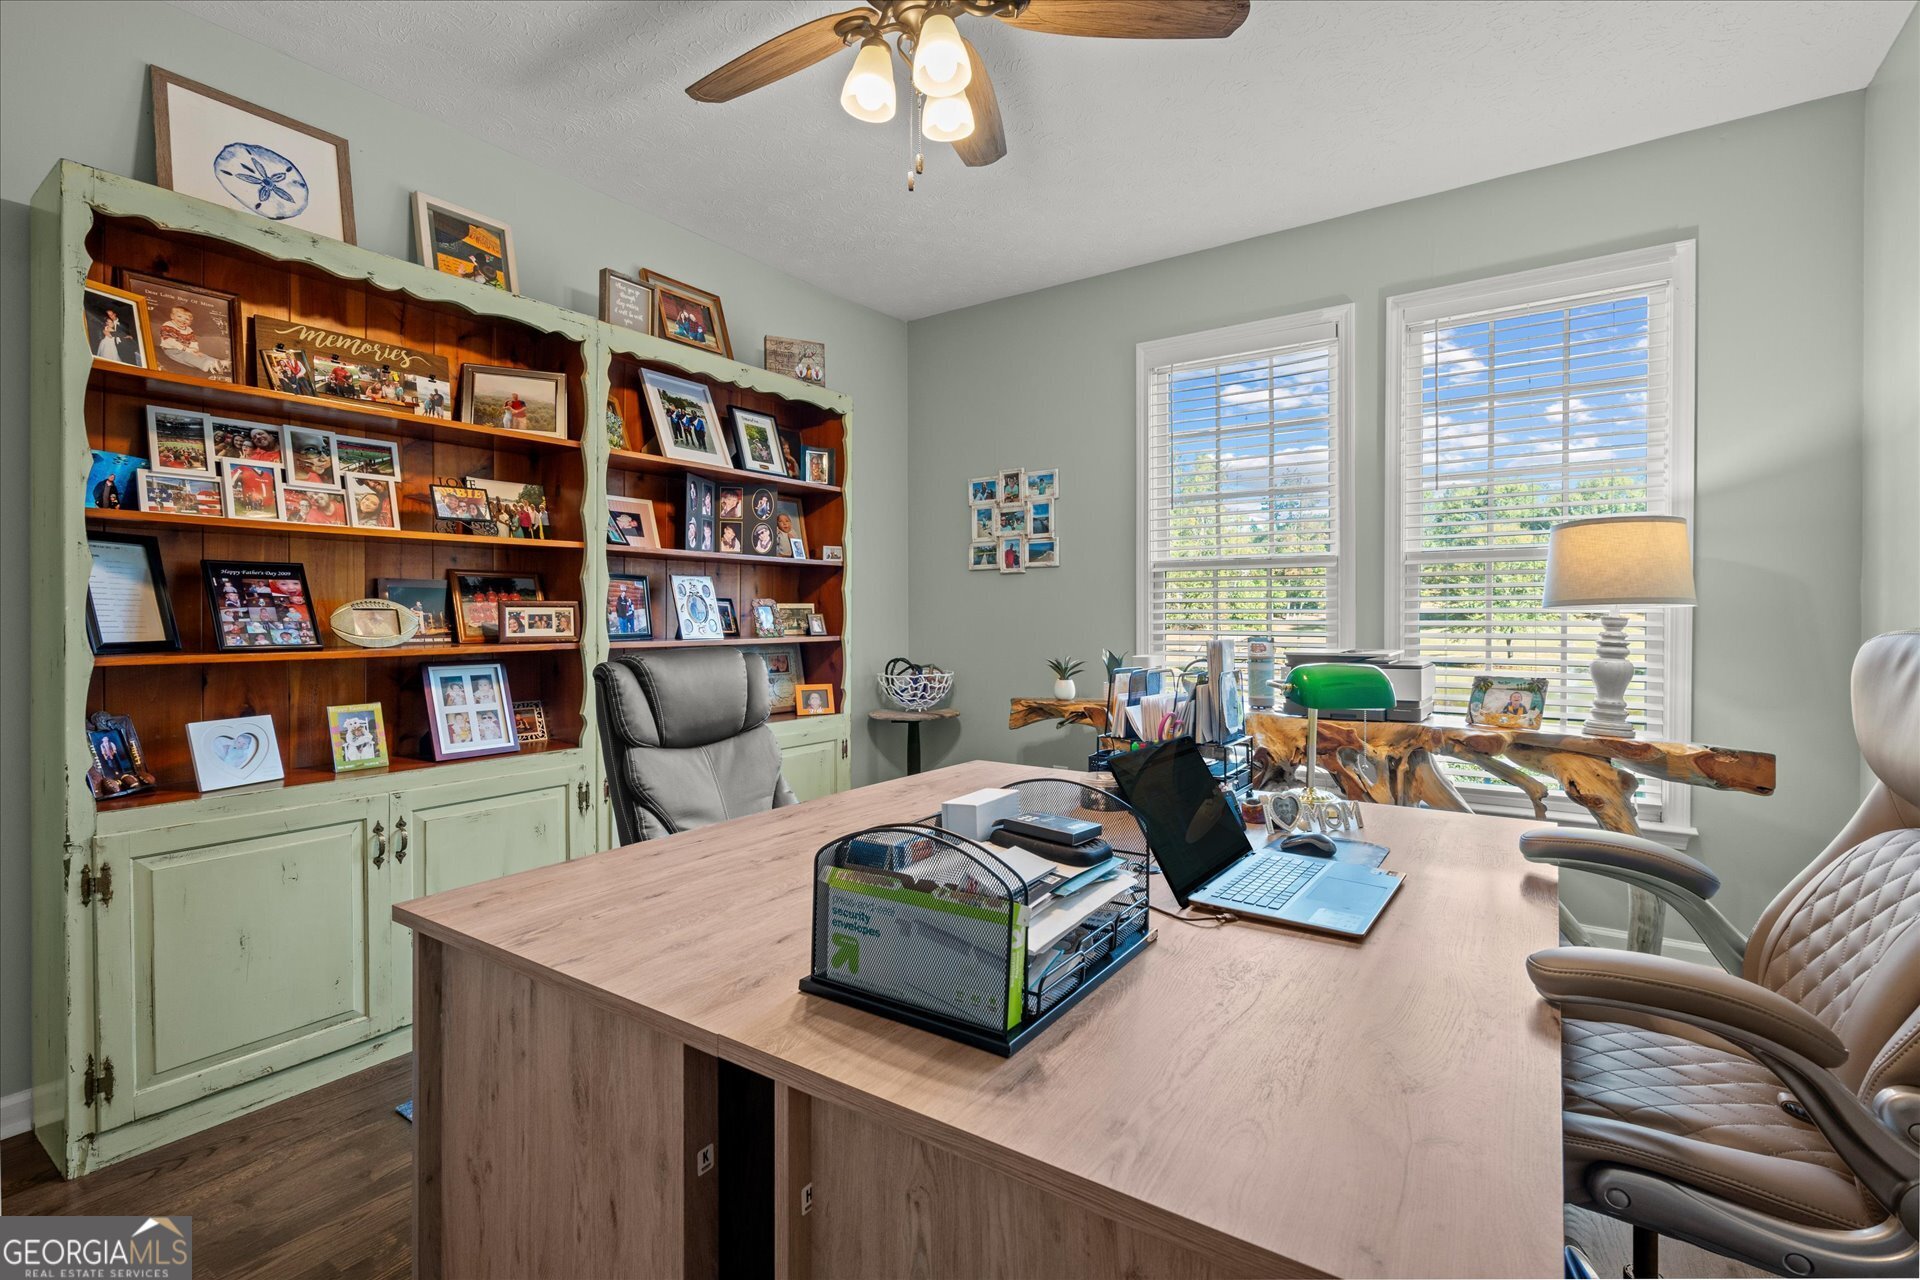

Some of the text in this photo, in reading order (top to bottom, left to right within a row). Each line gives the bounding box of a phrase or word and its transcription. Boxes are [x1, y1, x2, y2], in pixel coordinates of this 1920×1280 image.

[220, 568, 240, 576] Happy
[1301, 799, 1364, 833] MOM
[832, 906, 871, 925] security
[832, 918, 881, 938] envelopes
[702, 1149, 710, 1164] K
